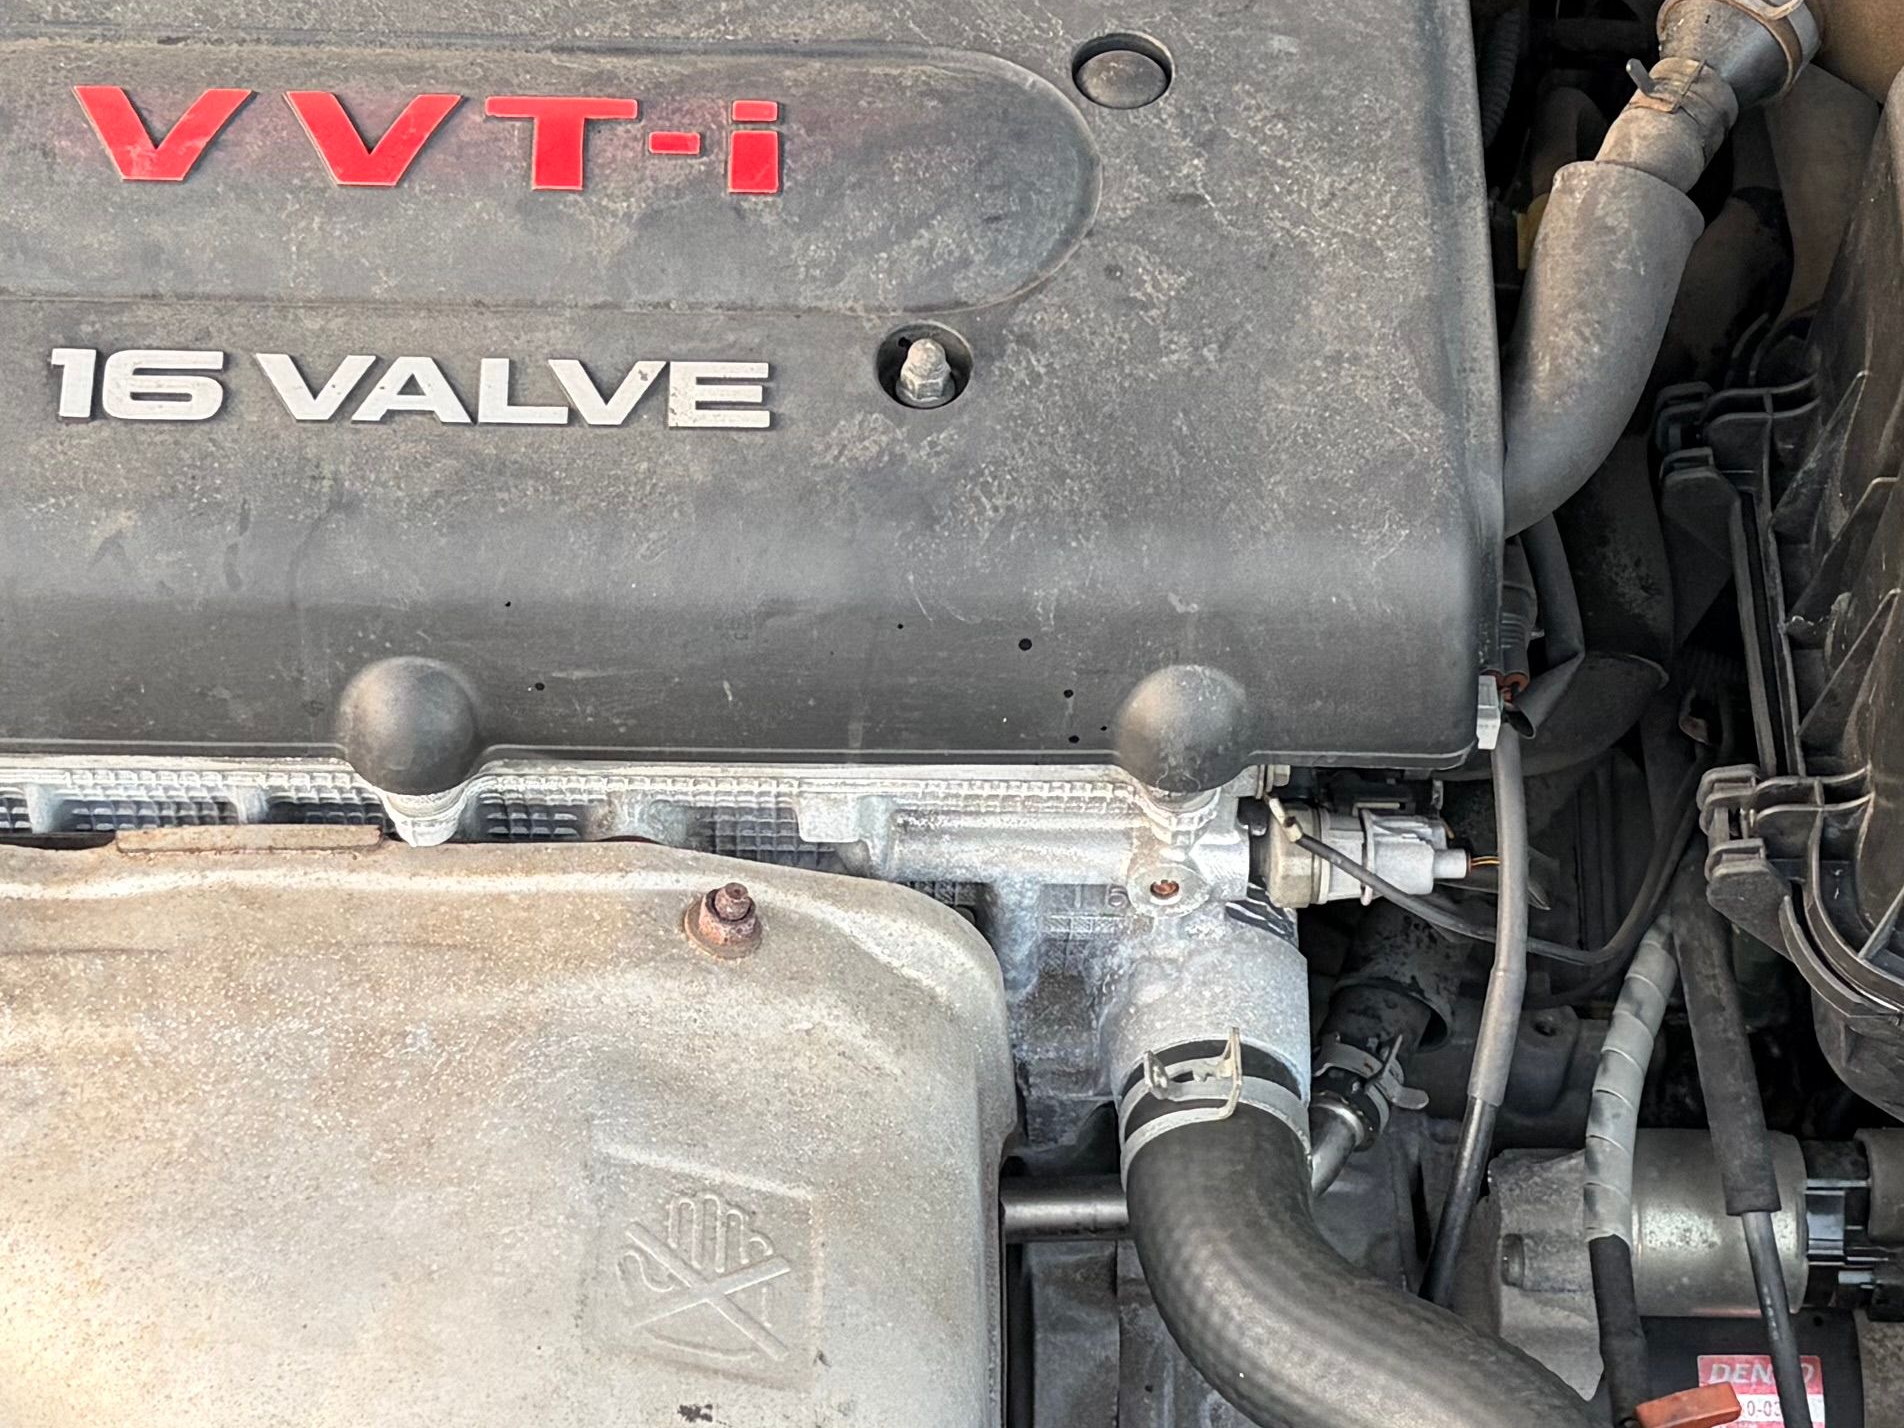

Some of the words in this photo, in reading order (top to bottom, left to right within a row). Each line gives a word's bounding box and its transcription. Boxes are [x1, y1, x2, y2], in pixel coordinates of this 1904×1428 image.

[50, 347, 224, 421] 16
[253, 351, 771, 428] VALVE
[1708, 1363, 1814, 1384] DENO
